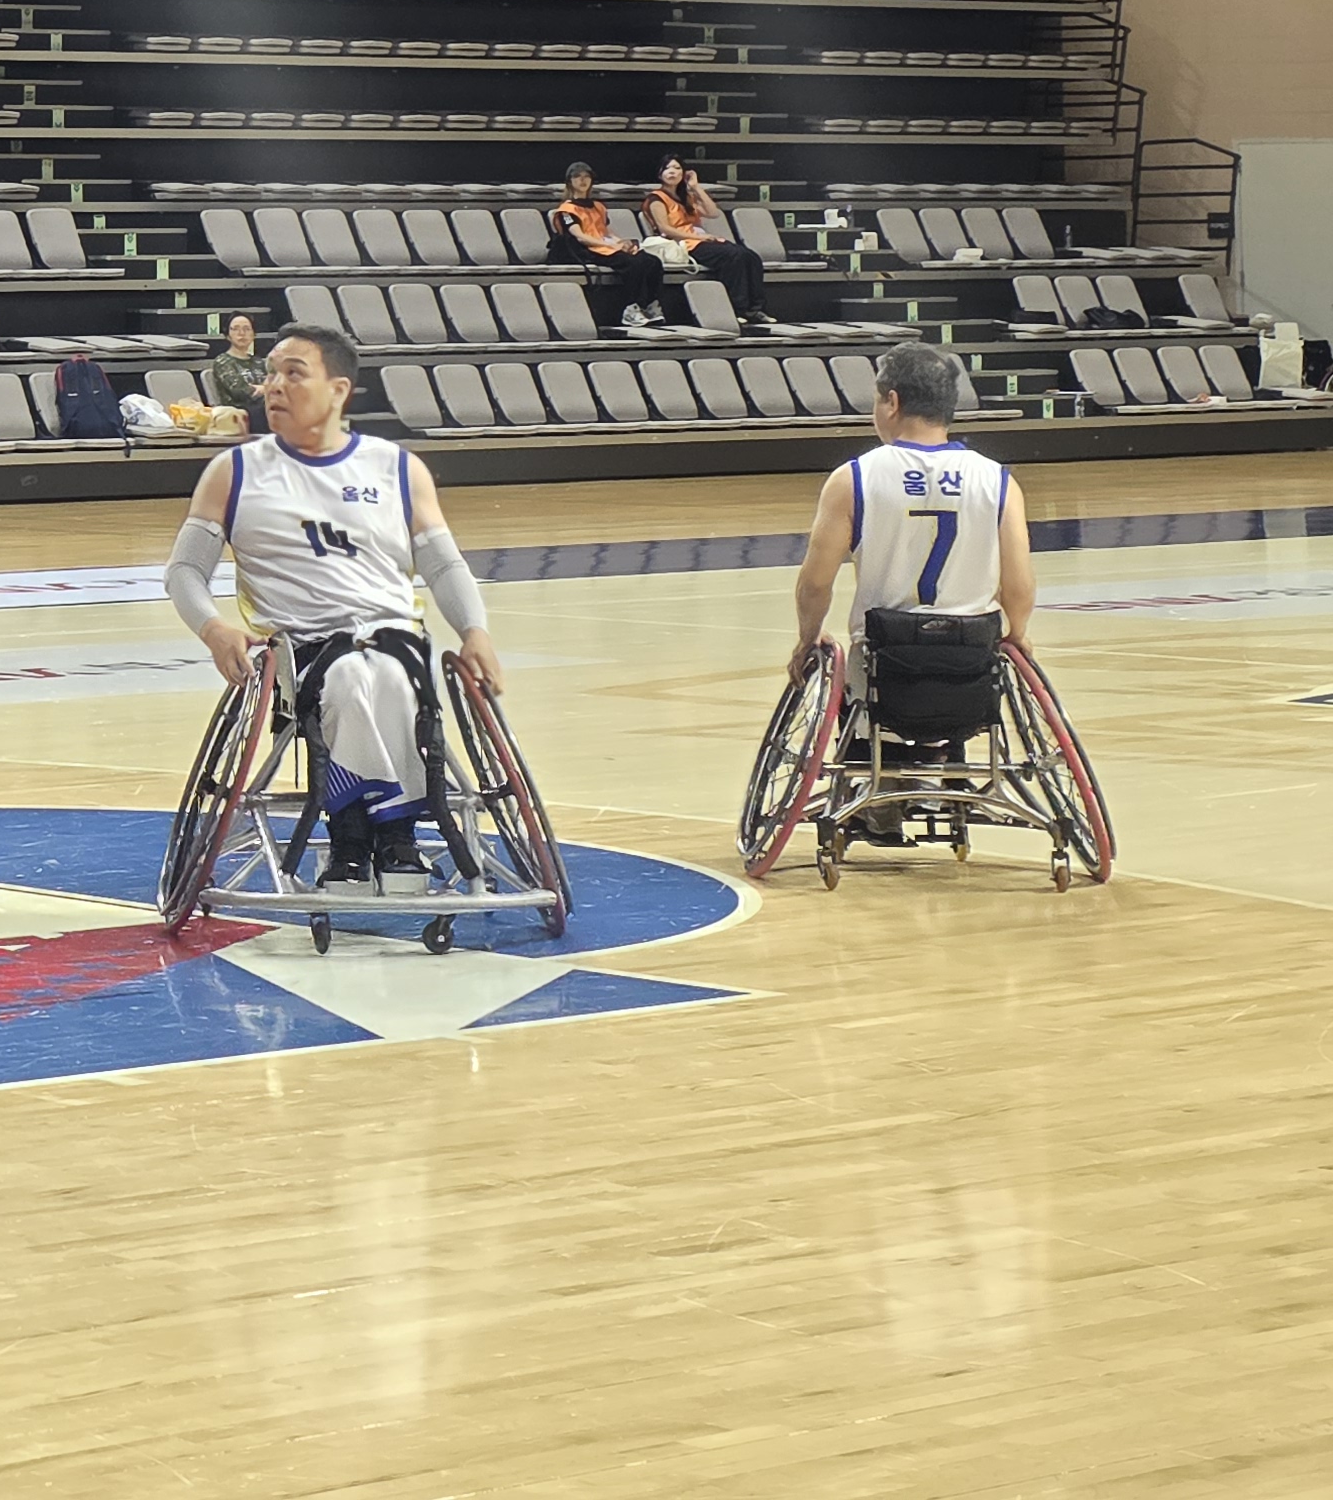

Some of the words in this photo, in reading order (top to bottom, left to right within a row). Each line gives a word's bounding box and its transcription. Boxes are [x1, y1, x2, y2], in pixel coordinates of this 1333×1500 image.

[341, 484, 380, 506] 울산
[902, 468, 963, 497] 울산
[300, 519, 358, 558] 14
[907, 508, 958, 607] 7
